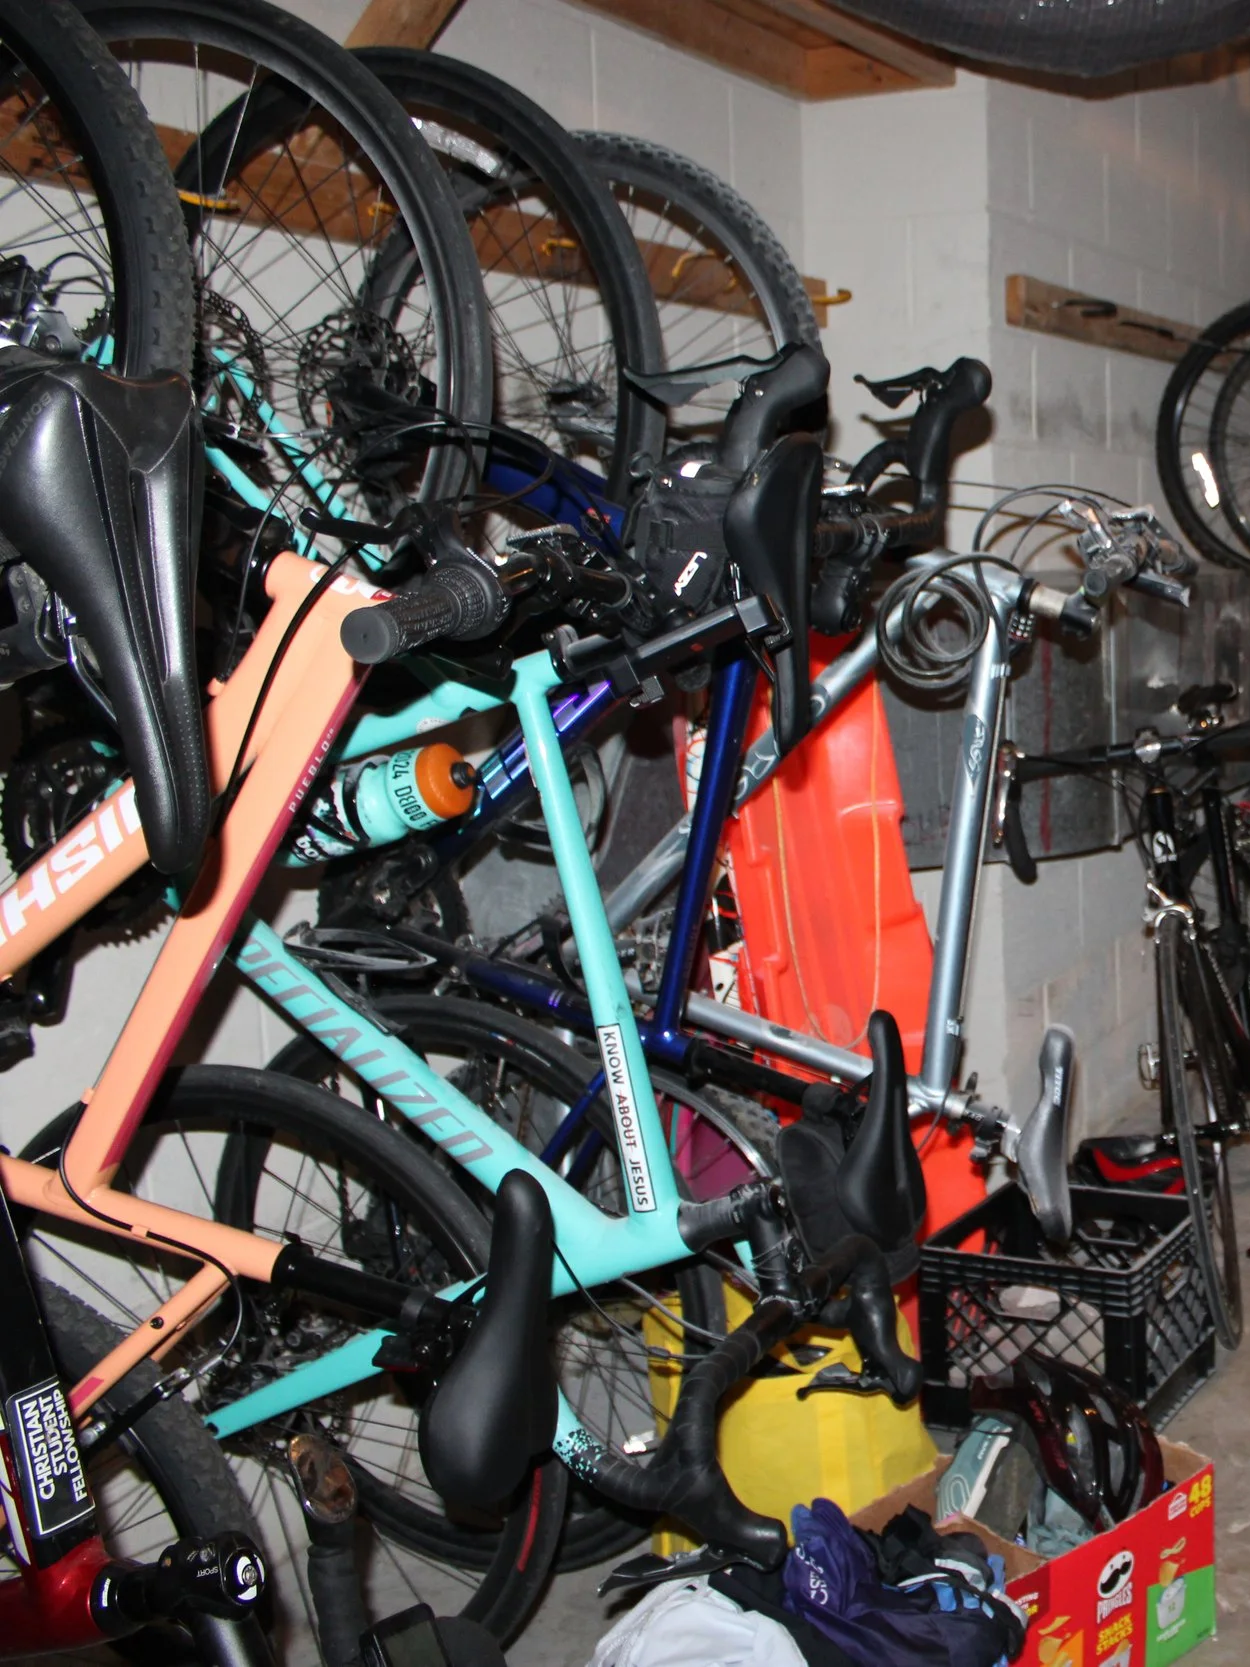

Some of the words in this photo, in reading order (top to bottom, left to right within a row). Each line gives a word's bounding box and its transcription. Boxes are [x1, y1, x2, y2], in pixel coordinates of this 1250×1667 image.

[289, 740, 331, 813] PUEBLO
[238, 932, 495, 1166] PECIALIZED
[604, 1031, 626, 1086] KNOW
[615, 1091, 638, 1150] ABOUT
[627, 1157, 651, 1211] JESUS
[22, 1399, 57, 1500] CHRISTIAN
[36, 1395, 67, 1477] STUDENT
[53, 1388, 87, 1503] FELLOWSHIP
[1189, 1474, 1212, 1503] 48
[1096, 1582, 1133, 1624] PRINGLES
